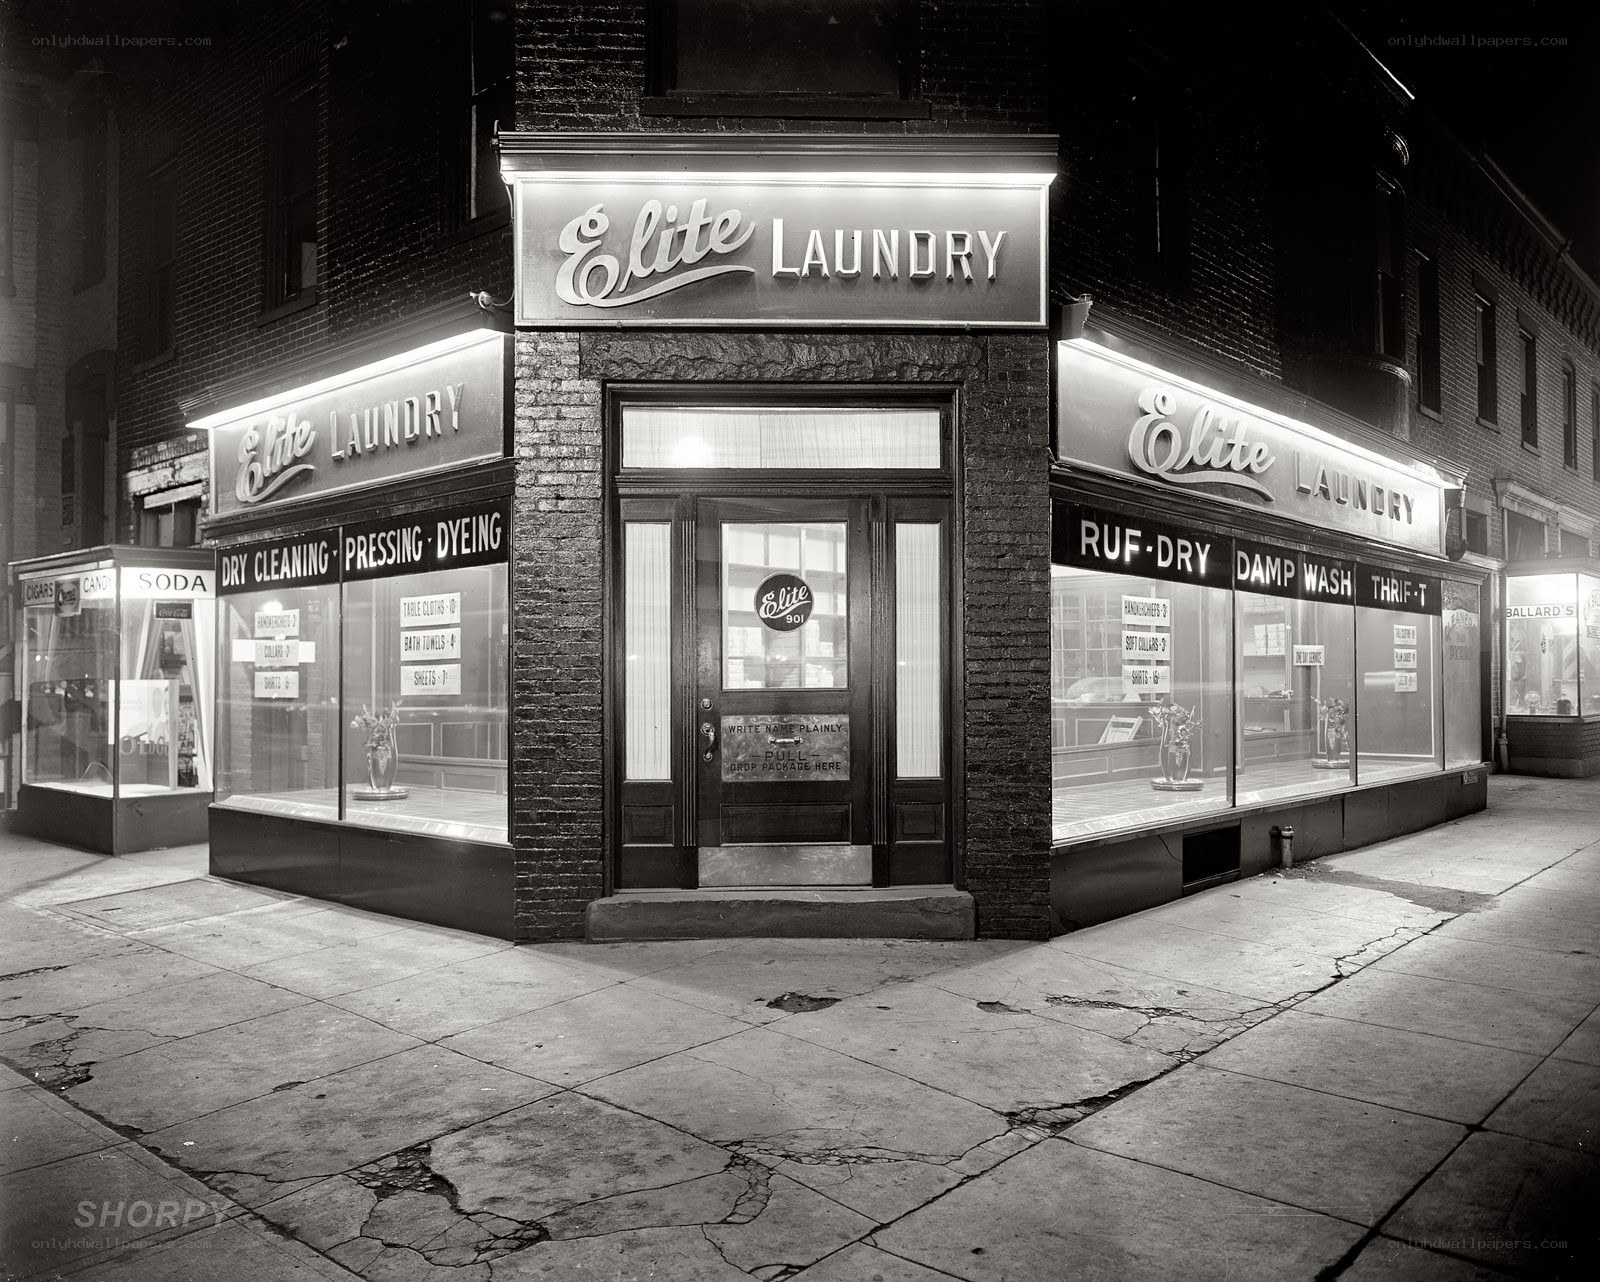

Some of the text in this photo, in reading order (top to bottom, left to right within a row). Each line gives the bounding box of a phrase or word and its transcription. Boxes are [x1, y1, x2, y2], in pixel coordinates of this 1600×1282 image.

[555, 198, 1008, 307] Elite LAUNDRY
[235, 382, 464, 504] Elite LAUNDRY
[1128, 386, 1416, 525] Elite LAUNDRY
[221, 512, 502, 587] DRY CLEANING PRESSING DYEING
[1236, 550, 1296, 588] DAMP
[1303, 562, 1352, 596] WASH
[139, 572, 207, 592] SODA
[26, 582, 54, 601] CIGARS
[403, 601, 421, 617] TABLE
[422, 600, 445, 615] CLOTHS
[759, 586, 811, 619] Elite
[786, 614, 804, 624] 901
[1506, 606, 1574, 618] BALLARD'S
[404, 635, 421, 651] BATH
[422, 634, 445, 651] TOWELS
[1125, 635, 1138, 651] SOFT
[1138, 636, 1159, 652] COLLARS
[413, 669, 436, 686] SHEETS
[1131, 669, 1149, 685] SHIRTS
[728, 724, 843, 734] WRITE NAME PLAINLY
[765, 751, 807, 761] PULL
[730, 762, 841, 772] DROP PACKAGE HERE
